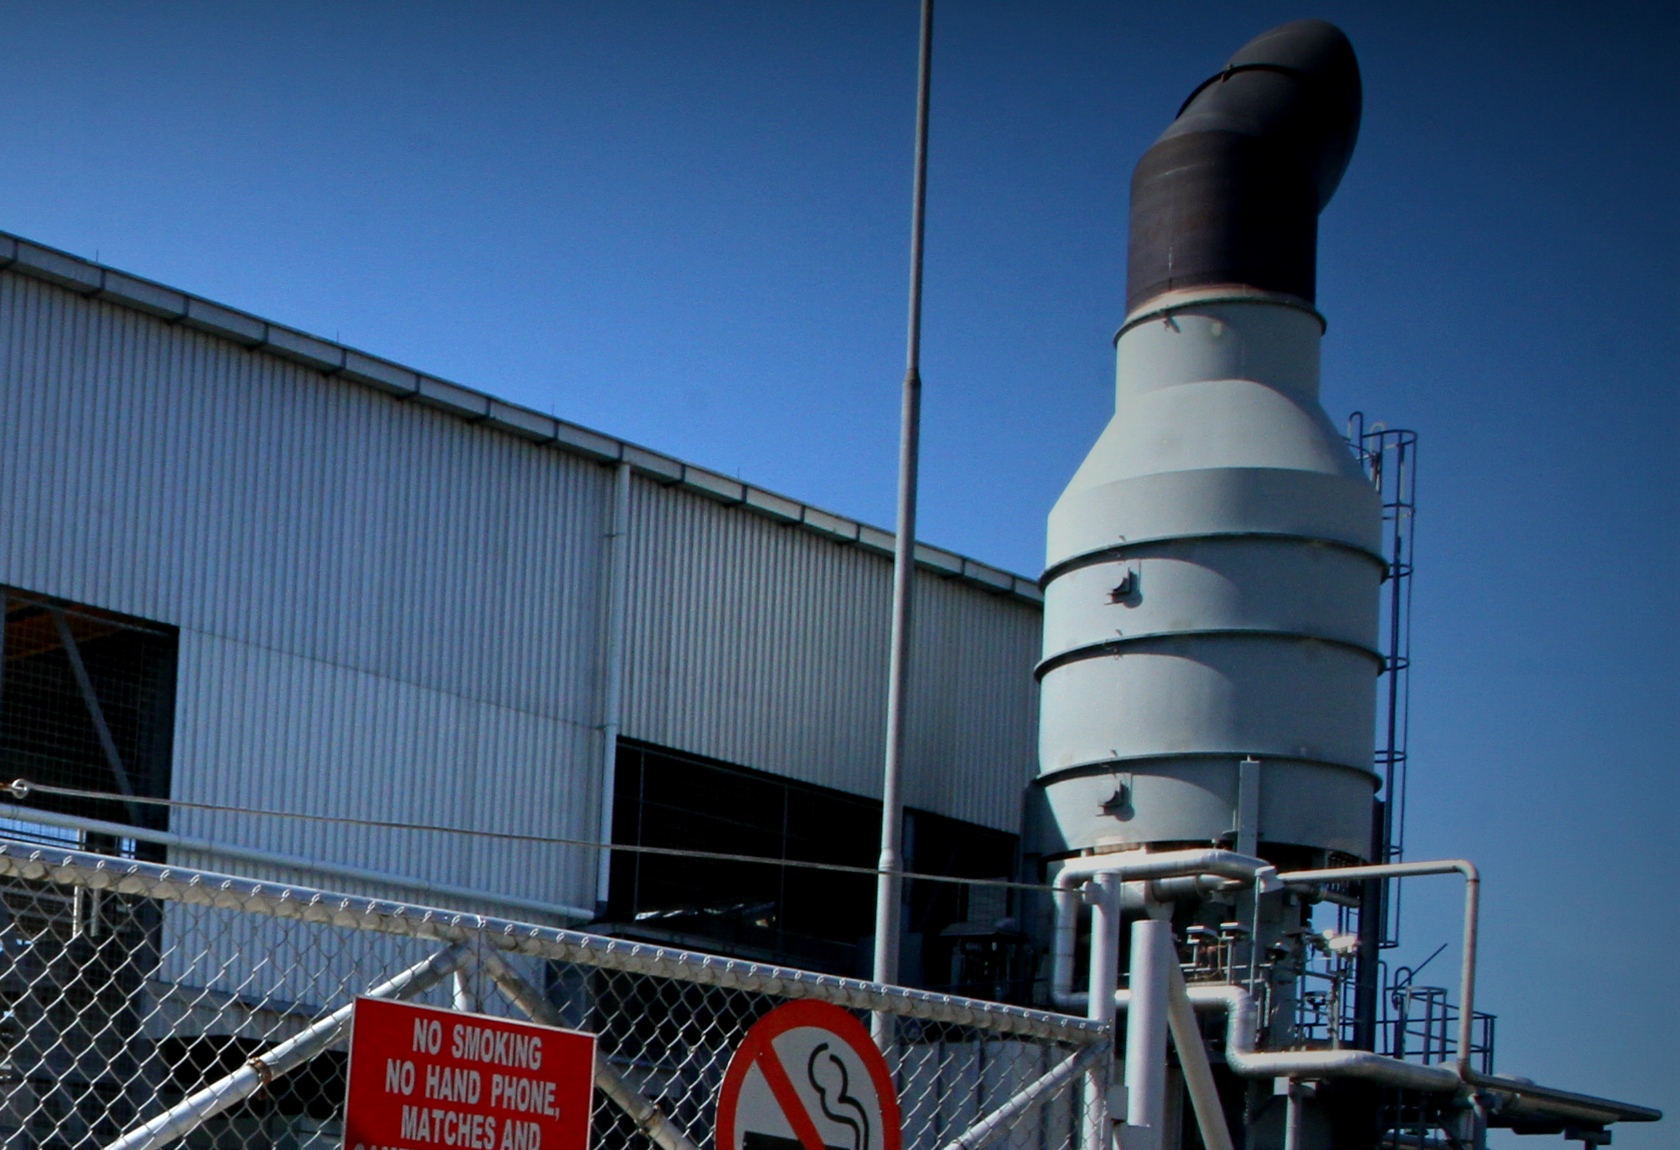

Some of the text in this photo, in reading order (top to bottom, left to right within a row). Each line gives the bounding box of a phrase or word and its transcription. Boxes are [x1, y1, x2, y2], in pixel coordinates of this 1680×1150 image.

[412, 1017, 542, 1070] NO SMOKING
[385, 1058, 560, 1121] NO HAND PHONE,
[400, 1104, 496, 1150] MATCHES
